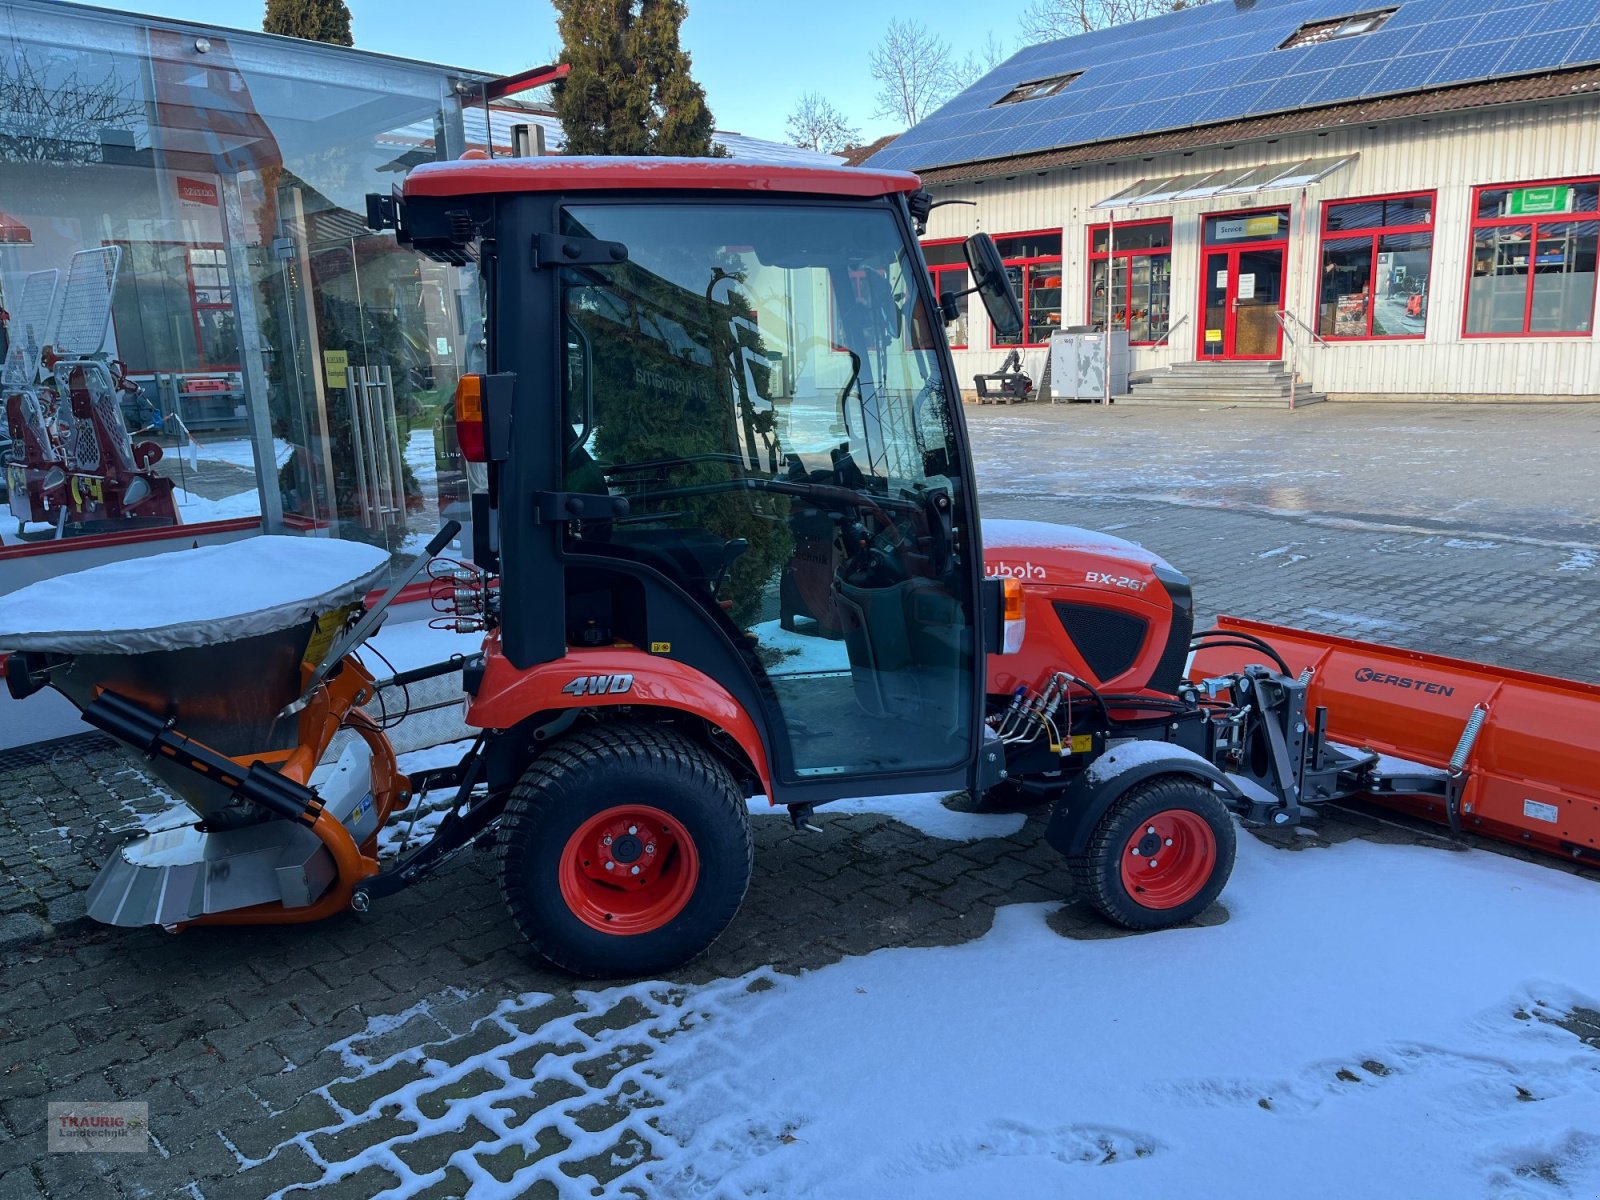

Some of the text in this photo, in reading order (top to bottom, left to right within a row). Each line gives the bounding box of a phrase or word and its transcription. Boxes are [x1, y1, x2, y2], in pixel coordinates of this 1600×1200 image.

[1220, 225, 1243, 233] Service
[984, 561, 1046, 578] ubota
[561, 673, 635, 697] 4WD
[1355, 668, 1455, 697] KERSTEN
